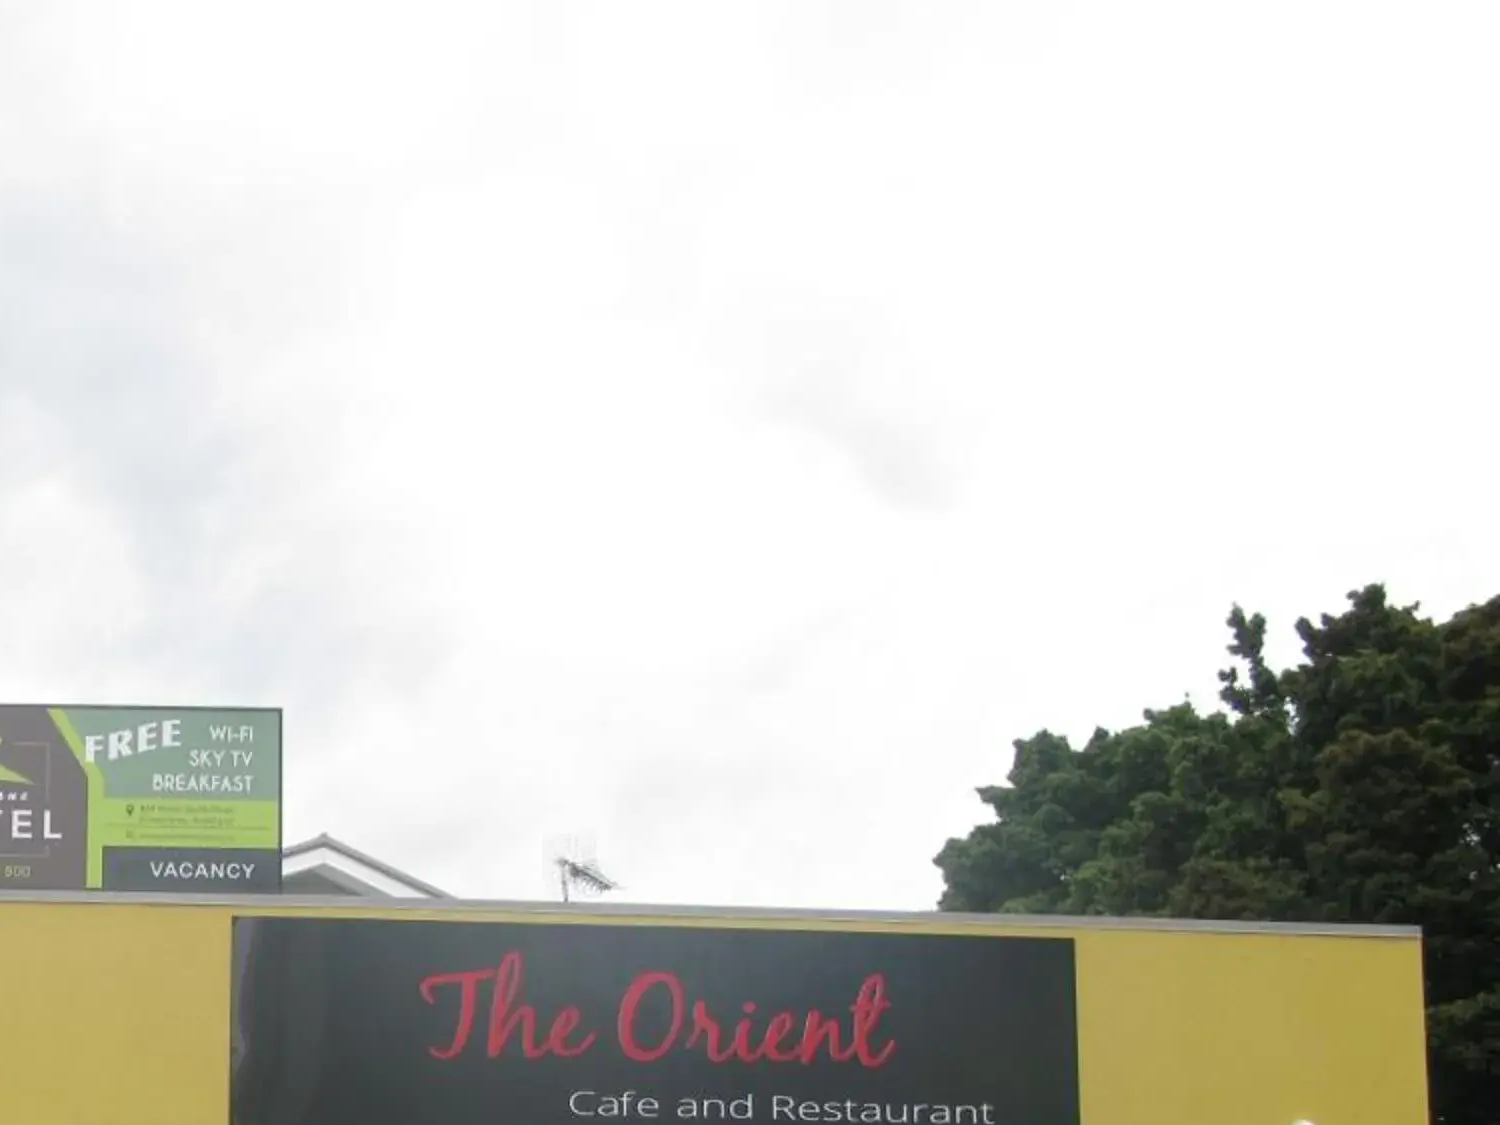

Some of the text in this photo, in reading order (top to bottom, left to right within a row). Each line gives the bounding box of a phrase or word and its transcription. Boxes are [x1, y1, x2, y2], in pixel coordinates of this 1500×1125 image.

[85, 719, 182, 763] FREE
[209, 725, 254, 743] WI-FI
[189, 751, 253, 769] SKY TV
[152, 773, 254, 794] BREAKFAST
[150, 861, 255, 880] VACANCY
[420, 952, 896, 1070] The Orient
[569, 1090, 995, 1125] Cafe and Restaurant
